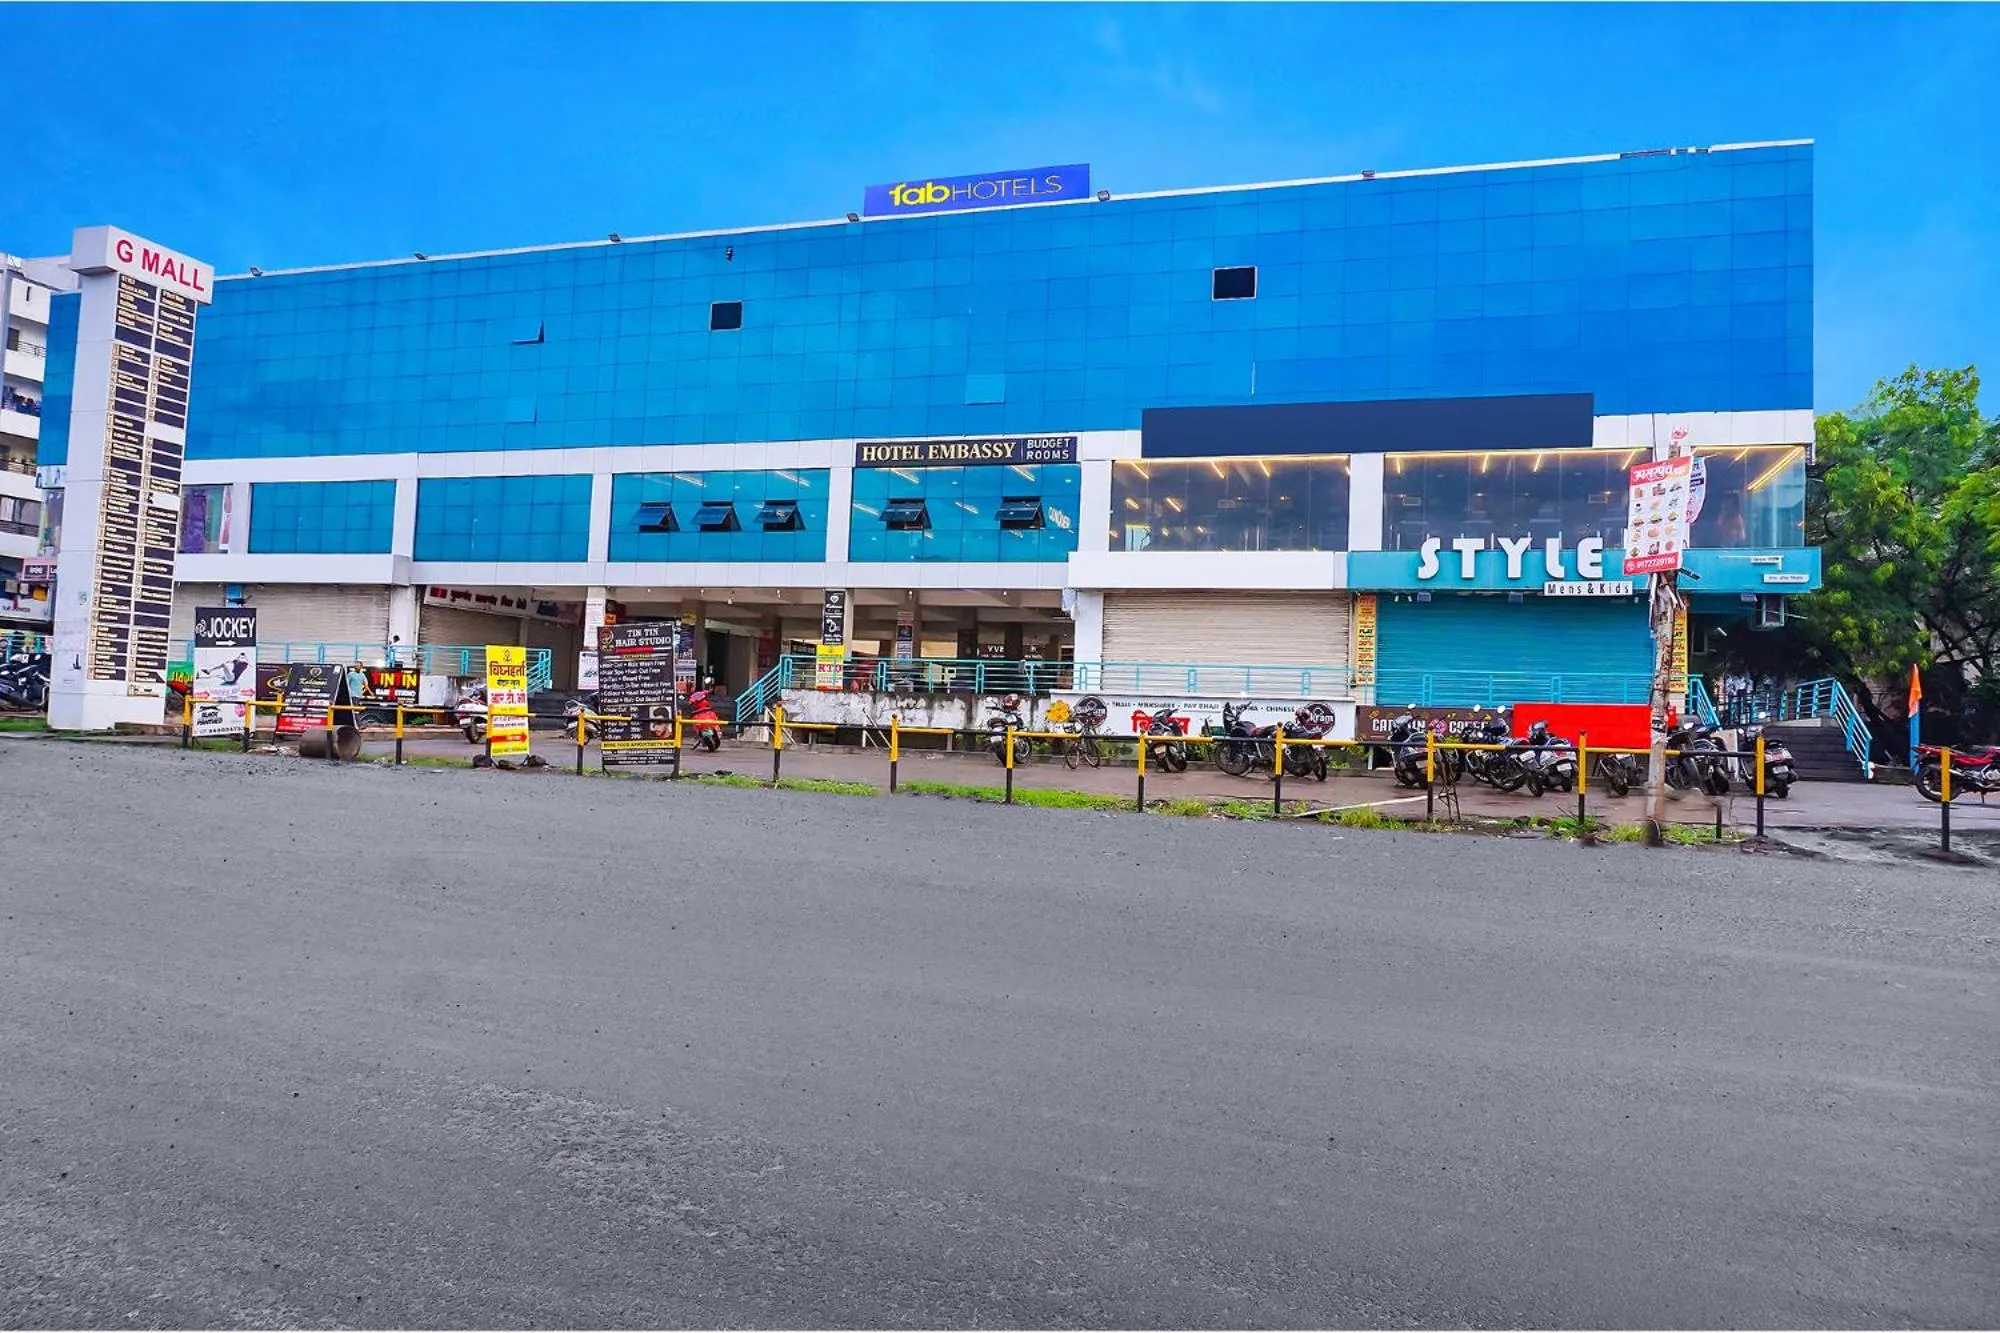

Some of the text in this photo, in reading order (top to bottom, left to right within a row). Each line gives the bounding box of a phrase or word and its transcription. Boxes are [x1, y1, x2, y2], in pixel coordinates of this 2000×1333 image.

[116, 239, 205, 292] G MALL
[862, 442, 1016, 461] HOTEL EMBASSY
[1026, 438, 1071, 449] BUDGET
[1026, 449, 1070, 460] ROOMS
[1417, 537, 1604, 579] STYLE
[207, 617, 255, 638] JOCKEY
[615, 636, 671, 646] HAIR STUDIO
